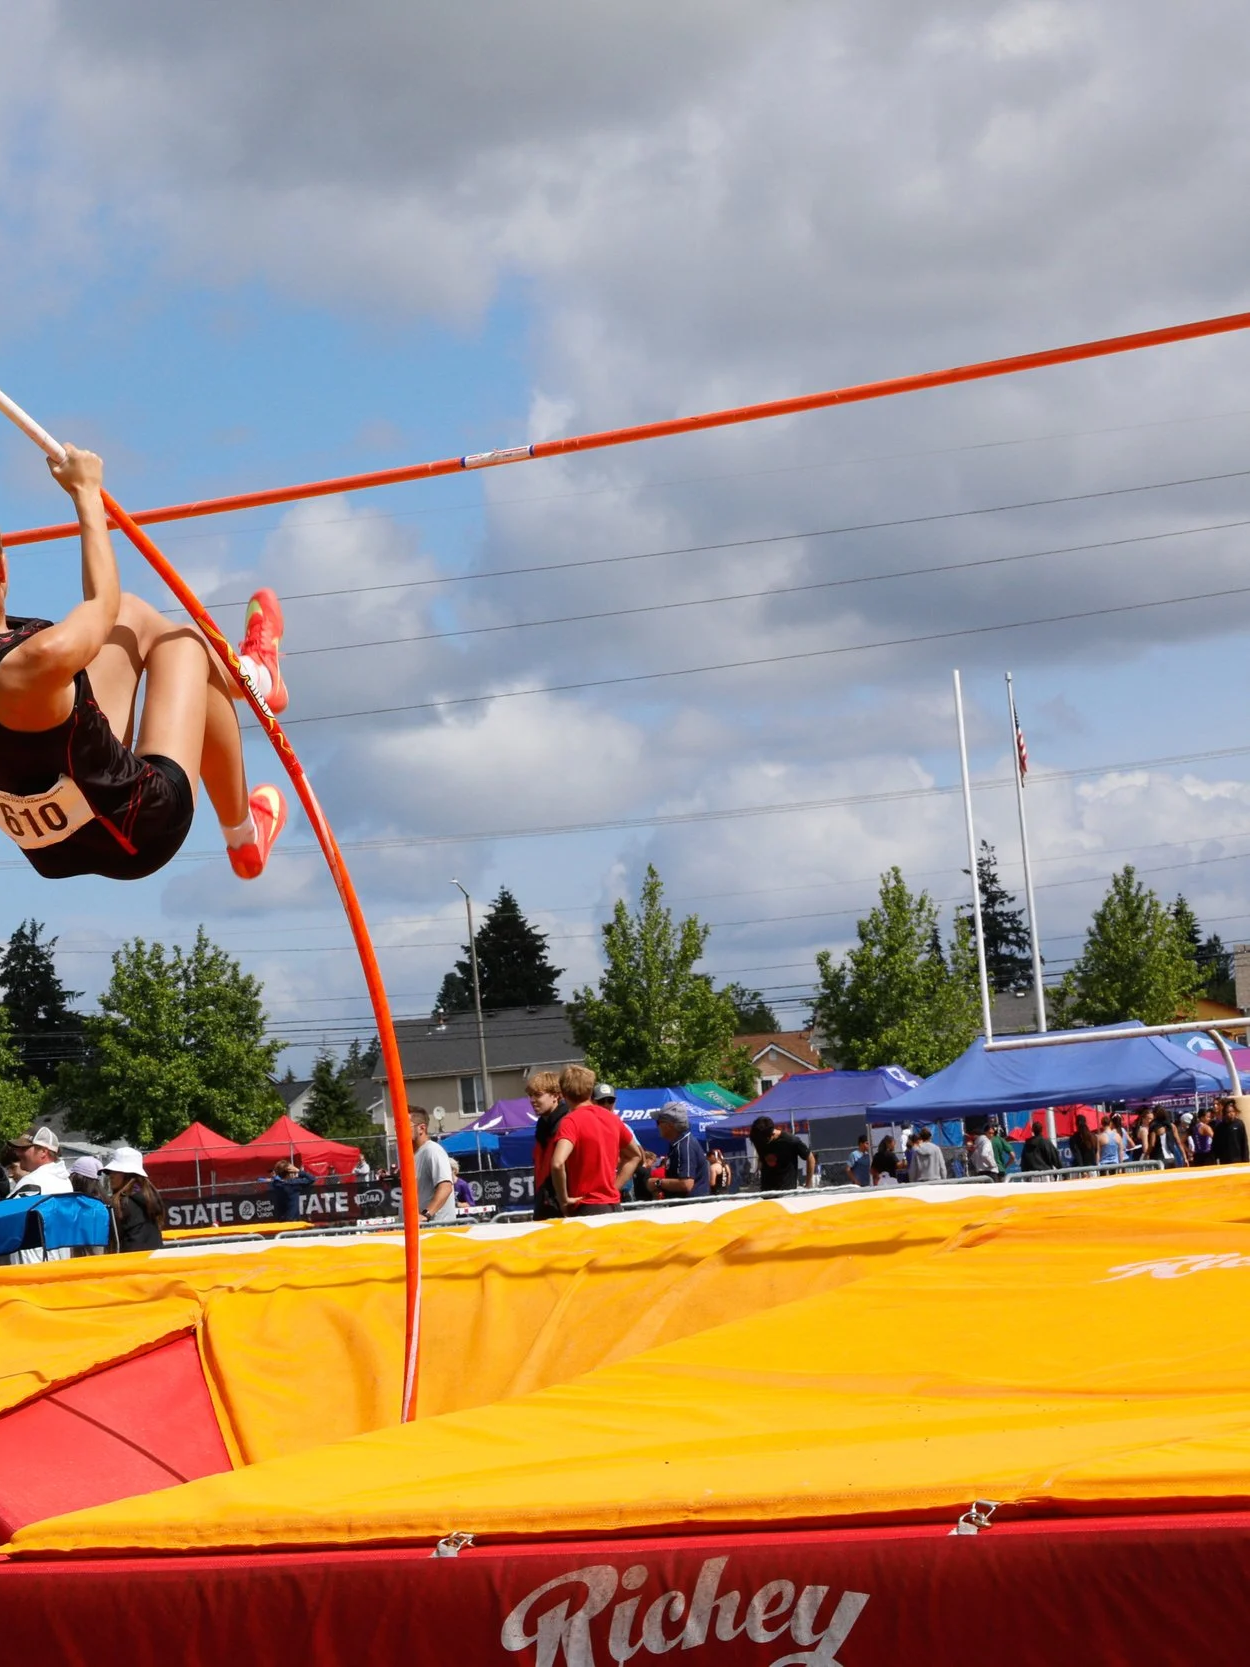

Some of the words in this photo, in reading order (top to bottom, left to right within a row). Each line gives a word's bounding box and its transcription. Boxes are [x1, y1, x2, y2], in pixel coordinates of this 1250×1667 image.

[0, 801, 68, 837] 610
[168, 1201, 234, 1226] STATE
[501, 1556, 870, 1667] Richey
